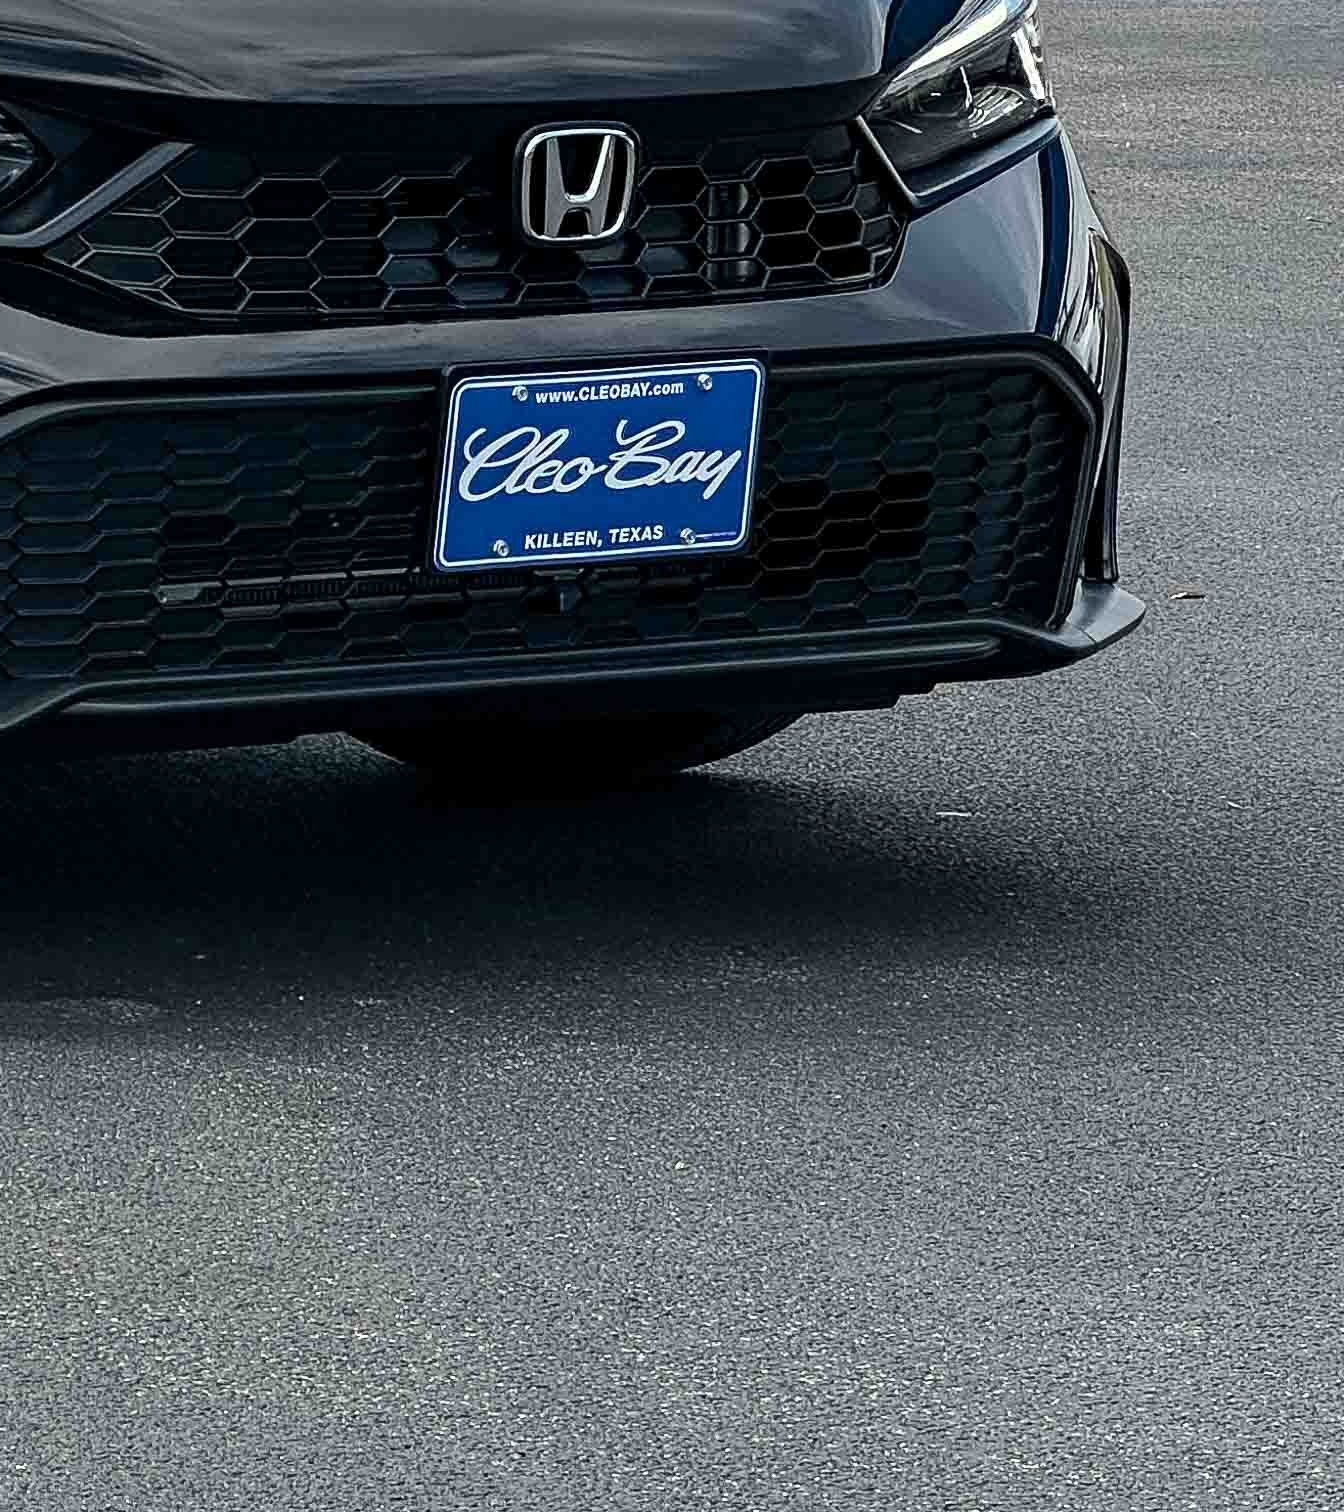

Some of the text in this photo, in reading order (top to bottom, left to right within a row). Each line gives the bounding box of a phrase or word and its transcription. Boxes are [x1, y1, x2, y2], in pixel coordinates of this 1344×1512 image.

[535, 381, 685, 404] www.CLEOBAY.com
[458, 418, 742, 503] Cleo Bay
[524, 524, 664, 551] KILLEEN, TEXAS
